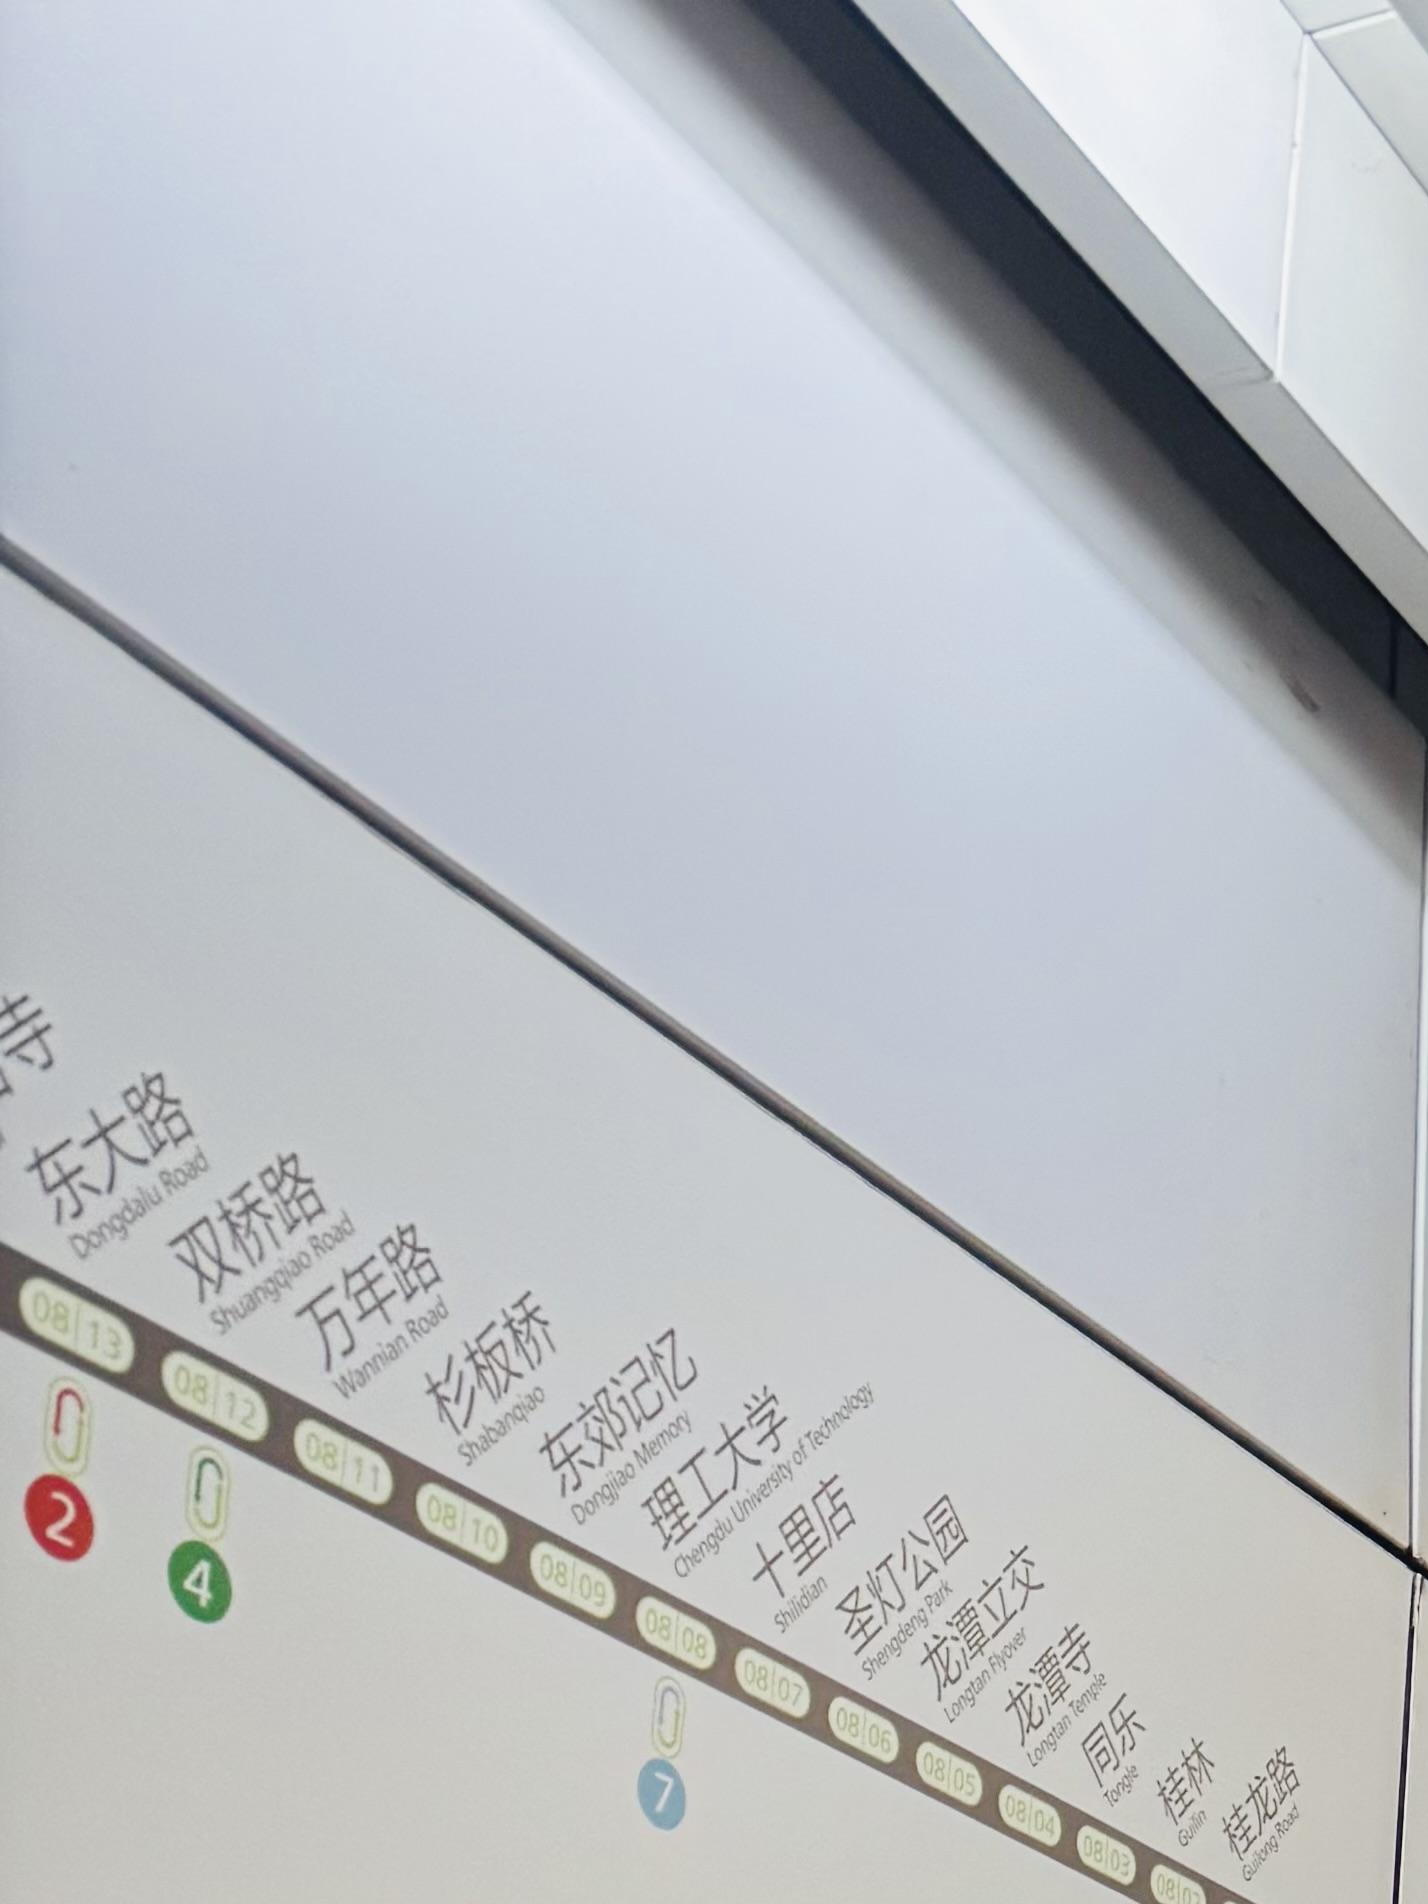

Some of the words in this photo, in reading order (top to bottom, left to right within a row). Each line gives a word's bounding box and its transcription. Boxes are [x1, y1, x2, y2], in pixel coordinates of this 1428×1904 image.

[25, 1071, 195, 1226] 东大路
[68, 1186, 163, 1260] Dongdalu
[158, 1144, 210, 1198] Road
[168, 1152, 327, 1303] 双桥路
[208, 1250, 313, 1335] Shuangqiao
[309, 1209, 357, 1262] Road
[295, 1223, 443, 1372] 万年路
[333, 1329, 408, 1400] Wannian
[404, 1294, 450, 1344] Road
[424, 1290, 556, 1436] 杉板桥
[539, 1328, 698, 1498] 东郊记忆
[456, 1384, 547, 1467] Shabanqiao
[570, 1465, 637, 1526] Dongjiao
[633, 1409, 693, 1470] Memory
[641, 1385, 789, 1551] 理工大学
[673, 1518, 734, 1579] Chengdu
[731, 1457, 797, 1523] University
[804, 1382, 877, 1450] Technology
[45, 1491, 77, 1548] 2
[752, 1474, 857, 1598] 十里店
[834, 1494, 969, 1656] 圣灯公园
[182, 1559, 213, 1607] 4
[773, 1574, 830, 1634] Shilidian
[860, 1606, 930, 1681] Shengdeng
[924, 1578, 955, 1615] Park
[920, 1545, 1045, 1702] 龙潭立交
[943, 1668, 994, 1723] Longtan
[988, 1626, 1030, 1677] Flyover
[1005, 1622, 1092, 1747] 龙潭寺
[1025, 1714, 1073, 1769] Longtan
[1070, 1671, 1108, 1717] Temple
[654, 1771, 675, 1814] 7
[1081, 1692, 1147, 1788] 同乐
[1103, 1763, 1140, 1809] Tongle
[1156, 1736, 1216, 1826] 桂林
[1178, 1808, 1208, 1847] Guilin
[1221, 1745, 1302, 1861] 桂龙路
[1241, 1836, 1281, 1882] Guilong
[1274, 1802, 1301, 1840] Road
